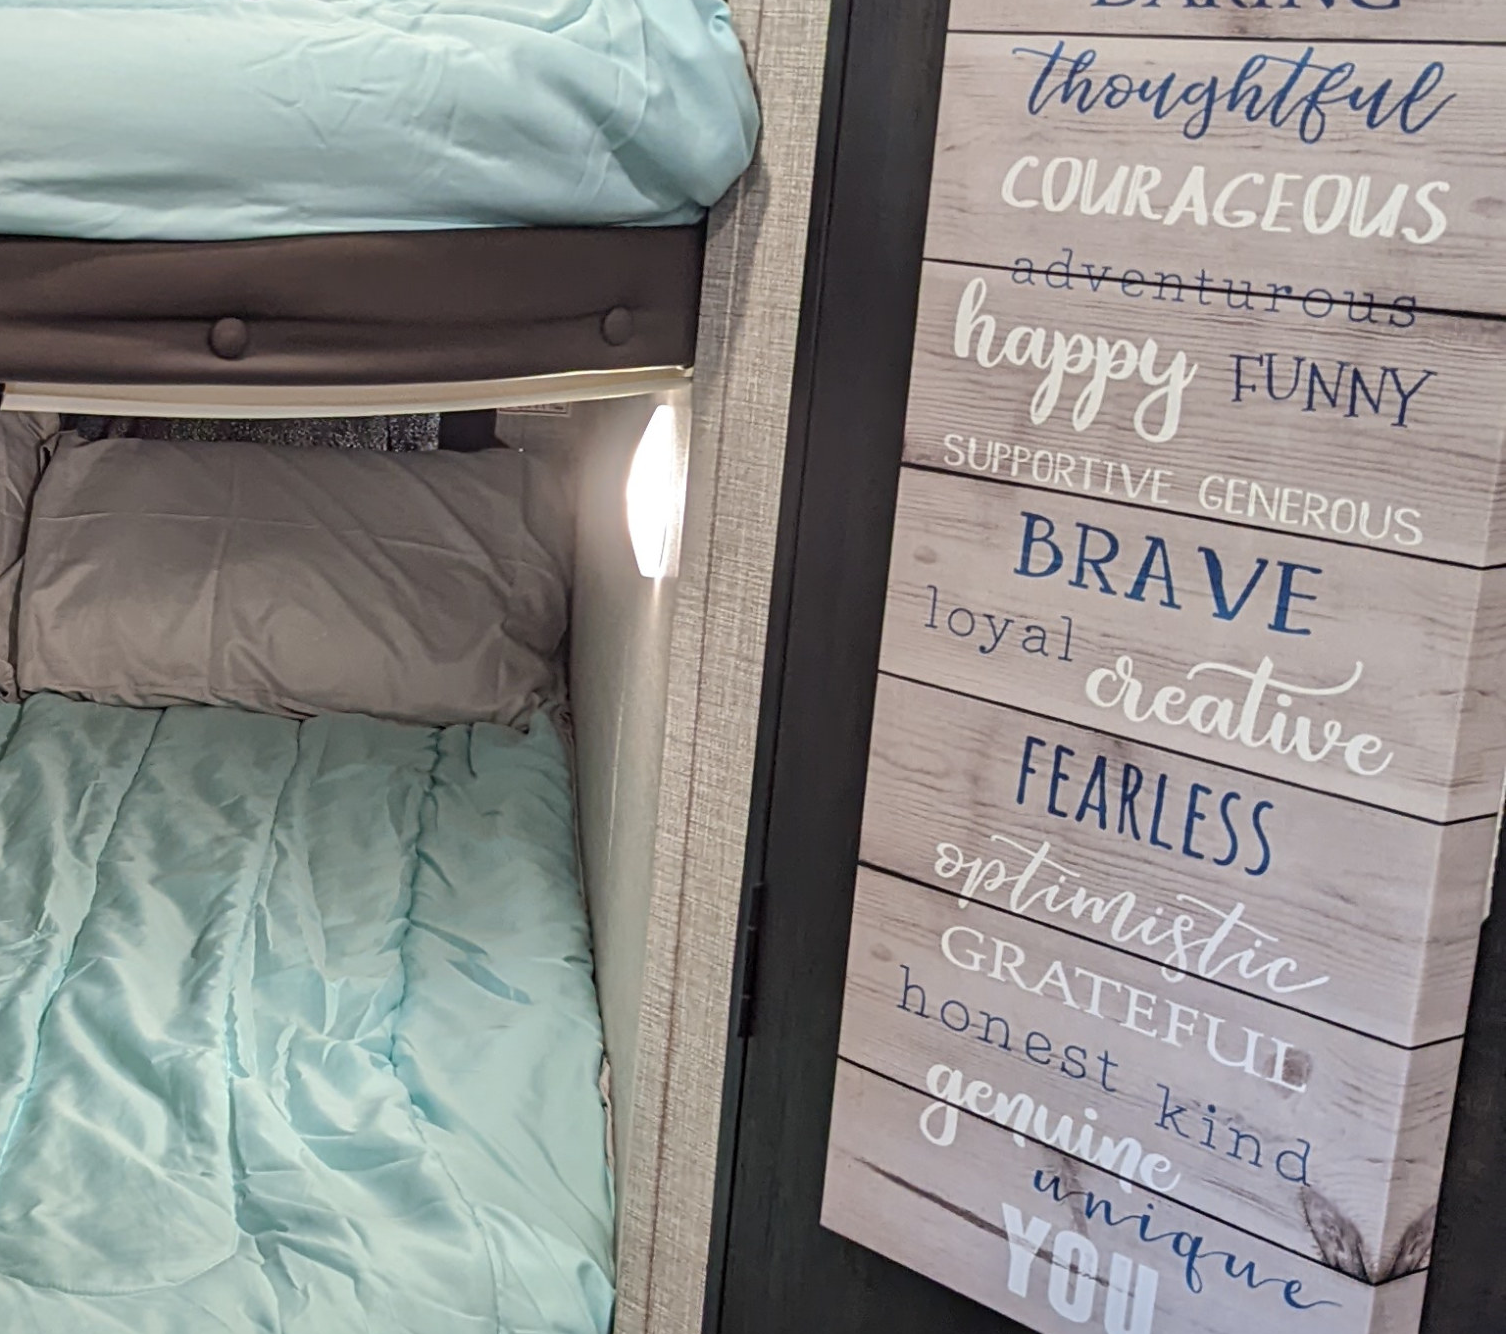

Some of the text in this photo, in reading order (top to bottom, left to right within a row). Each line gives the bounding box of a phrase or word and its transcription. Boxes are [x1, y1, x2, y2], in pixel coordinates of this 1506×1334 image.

[1012, 40, 1457, 145] thoughtful
[1000, 155, 1450, 245] COURAGEOUS
[1011, 248, 1420, 328] adventurous
[952, 277, 1437, 443] happy FUNNY
[943, 433, 1424, 546] SUPPORTIVE GENEROUS
[923, 585, 1074, 662] loyal
[1013, 510, 1324, 636] BRAVE
[1084, 655, 1394, 776] creative
[1015, 735, 1275, 877] FEARLESS
[933, 833, 1331, 994] optimistic
[940, 925, 1308, 1093] GRATEFUL
[896, 964, 1312, 1187] honest kind
[918, 1063, 1181, 1194] genuine
[1033, 1167, 1343, 1310] unique
